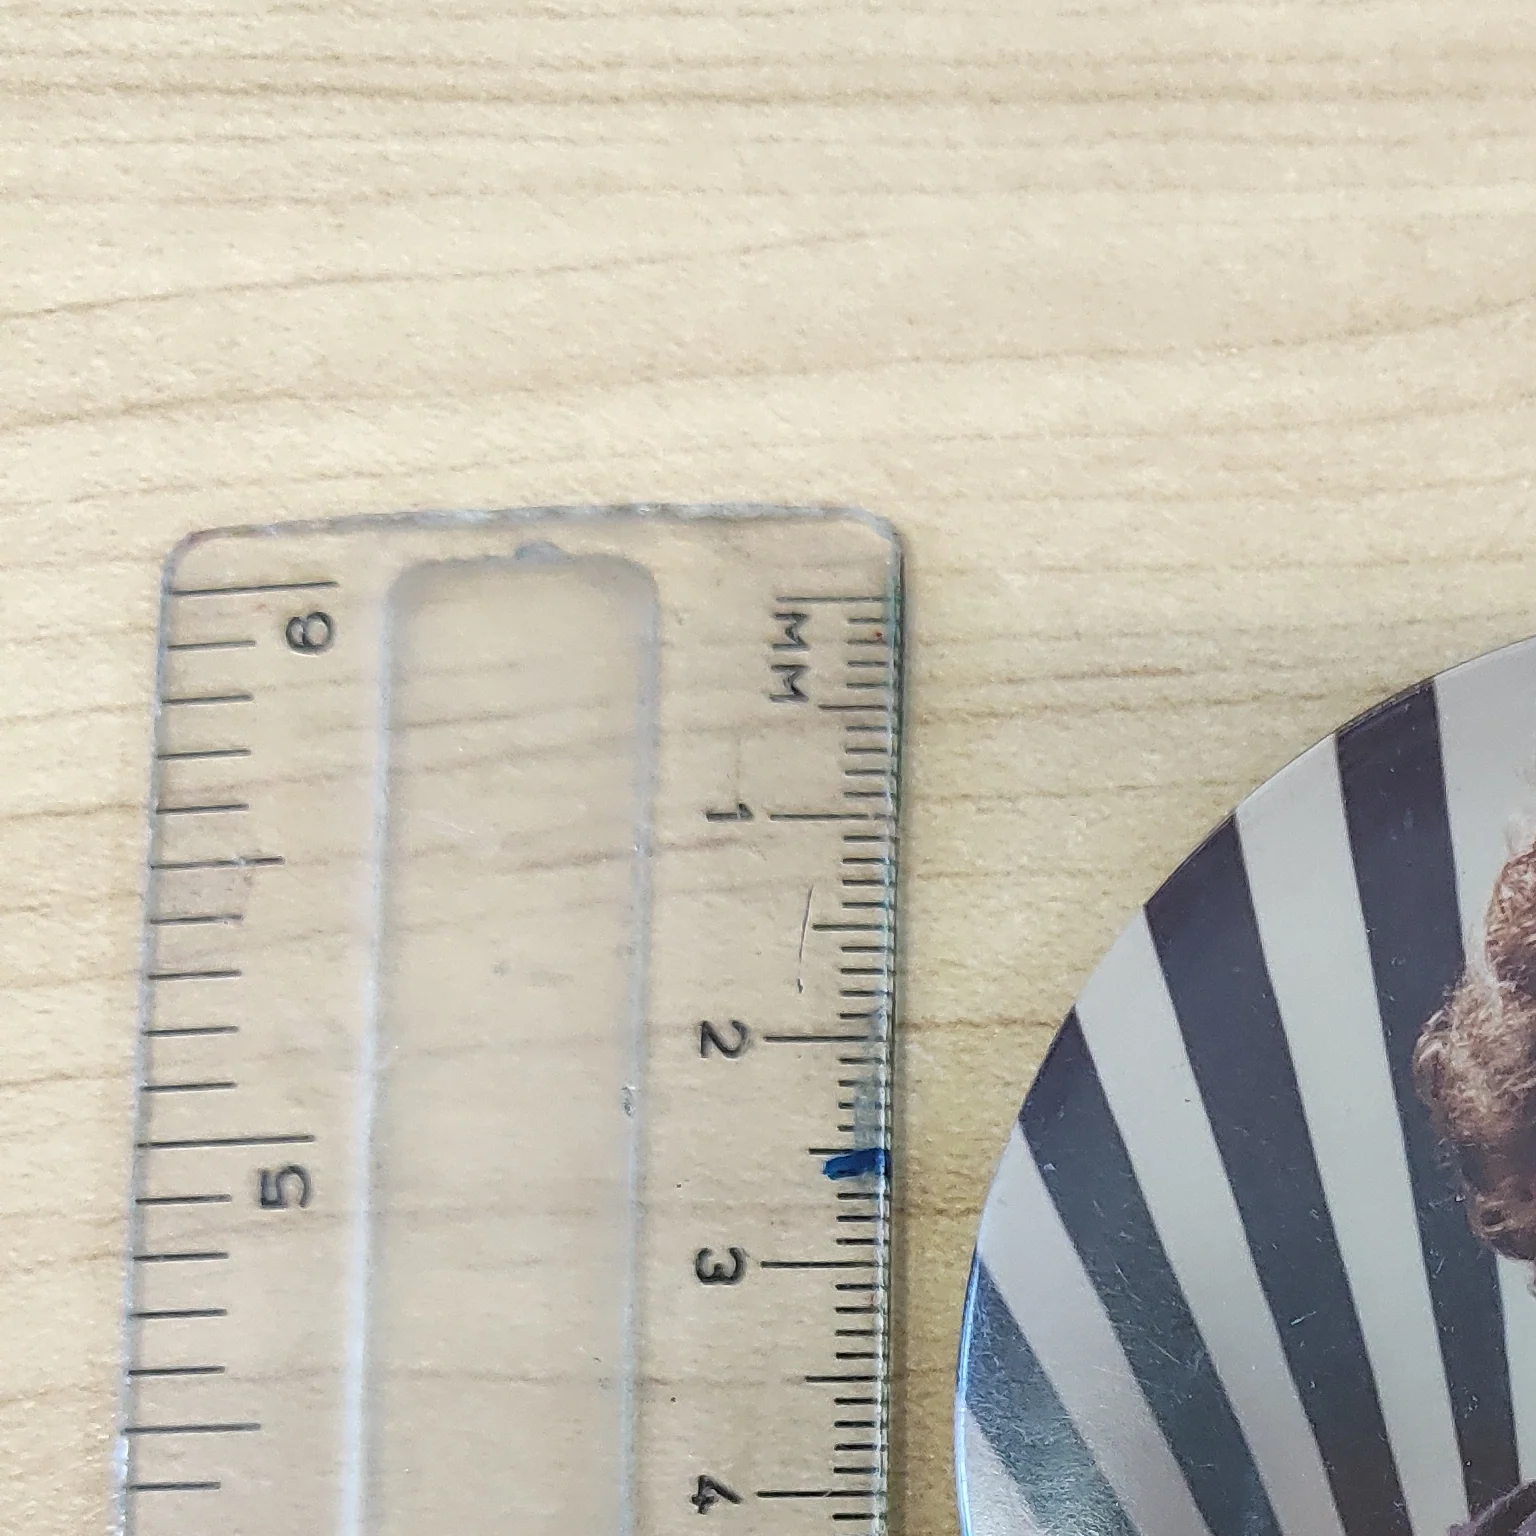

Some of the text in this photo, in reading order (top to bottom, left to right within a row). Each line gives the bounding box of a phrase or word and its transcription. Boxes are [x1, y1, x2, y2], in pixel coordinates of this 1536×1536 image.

[285, 611, 334, 654] 6
[769, 612, 810, 704] MM
[705, 803, 754, 824] 1
[700, 1020, 748, 1059] 2
[259, 1165, 312, 1210] 5
[695, 1246, 747, 1286] 3
[691, 1474, 743, 1514] 4
